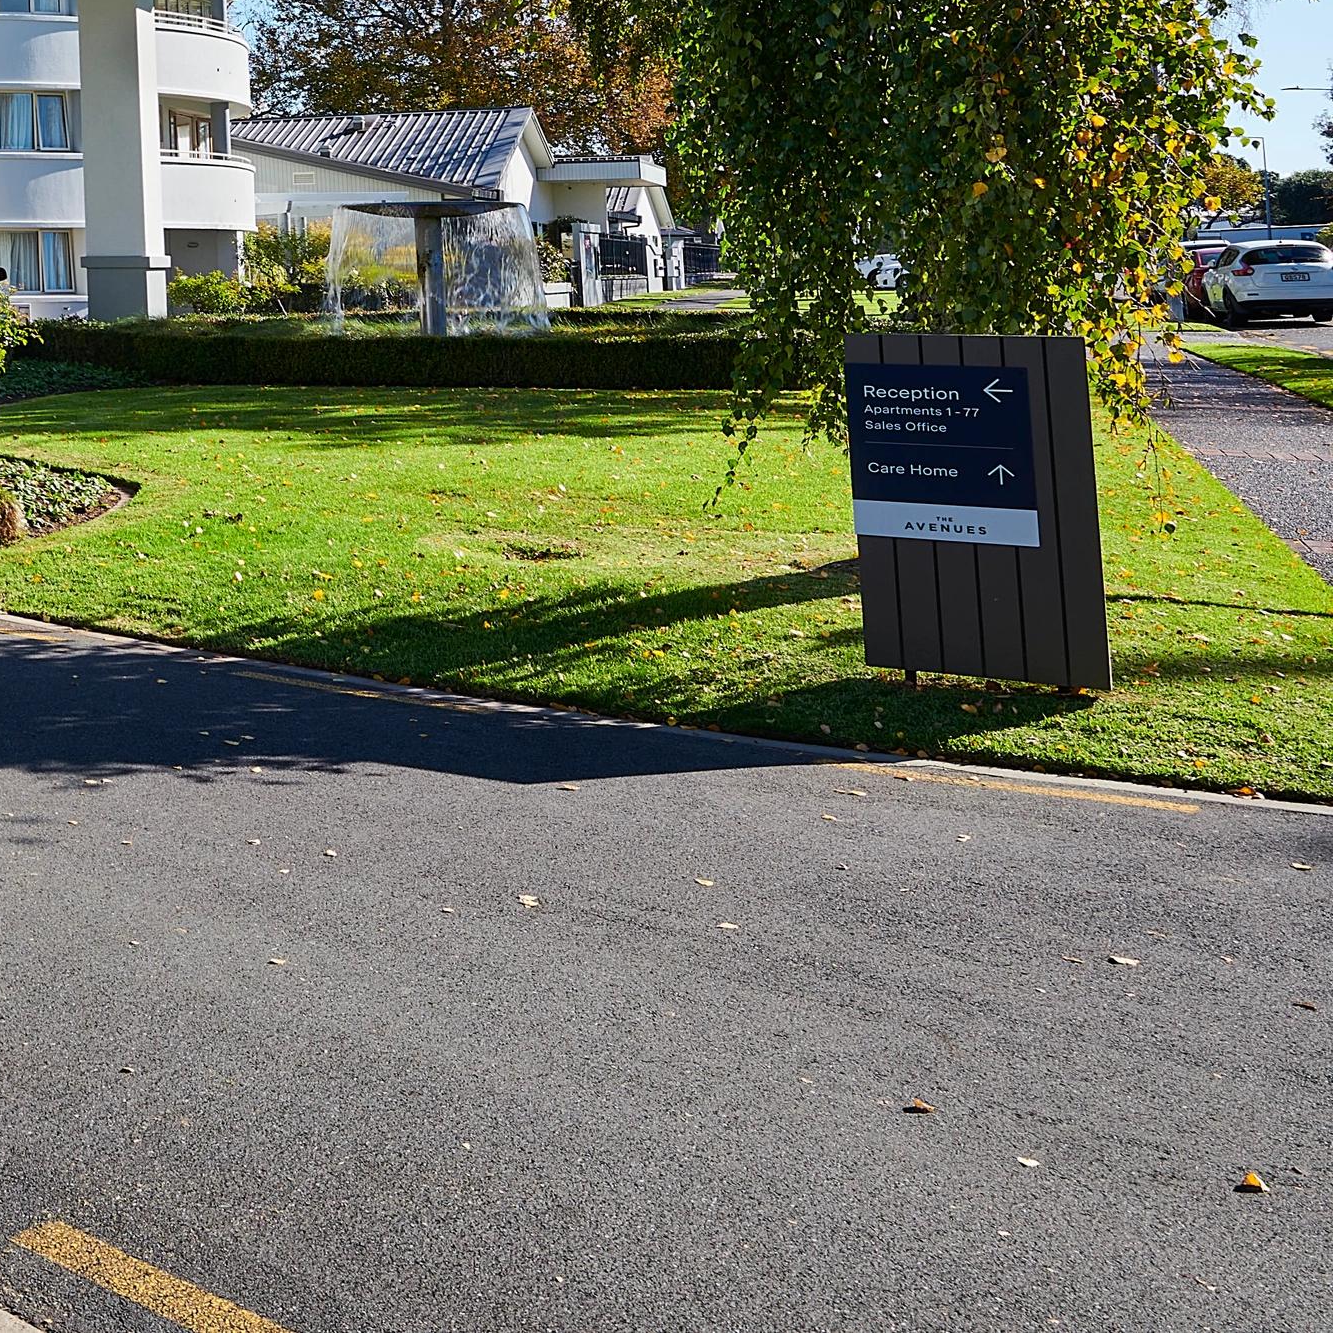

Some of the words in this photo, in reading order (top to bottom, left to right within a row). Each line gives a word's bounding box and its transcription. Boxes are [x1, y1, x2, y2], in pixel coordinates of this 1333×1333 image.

[863, 385, 960, 402] Reception
[864, 404, 943, 417] Apartments
[865, 420, 901, 431] Sales
[905, 421, 947, 433] Office
[867, 462, 905, 475] Care
[910, 464, 958, 477] Home
[904, 522, 987, 535] AVENUES
